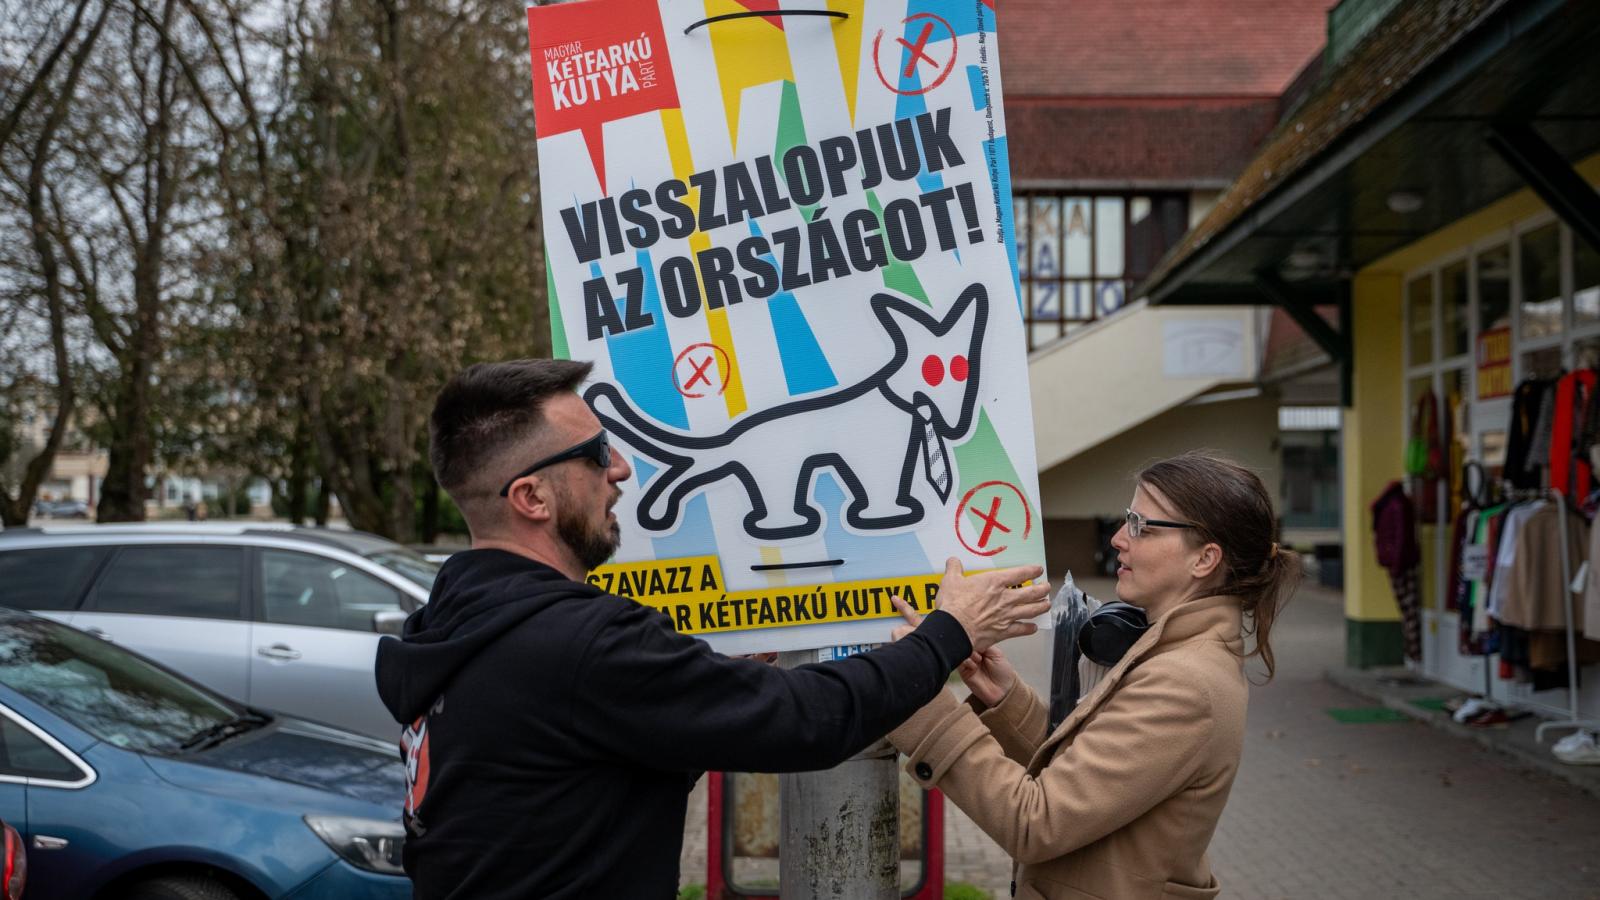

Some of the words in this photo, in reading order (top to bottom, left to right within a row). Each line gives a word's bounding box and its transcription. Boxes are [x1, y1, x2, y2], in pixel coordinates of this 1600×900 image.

[544, 41, 582, 60] MAGYAR
[546, 32, 652, 82] KÉTFARKÚ
[551, 65, 640, 111] KUTYA
[639, 61, 657, 88] PÁRT
[560, 107, 966, 264] VISSZALOPJUK
[582, 267, 655, 341] AZ
[659, 182, 985, 318] ORSZÁGOT!
[700, 565, 718, 591] A
[699, 586, 827, 629] KÉTFARKÚ
[836, 584, 919, 617] KUTYA
